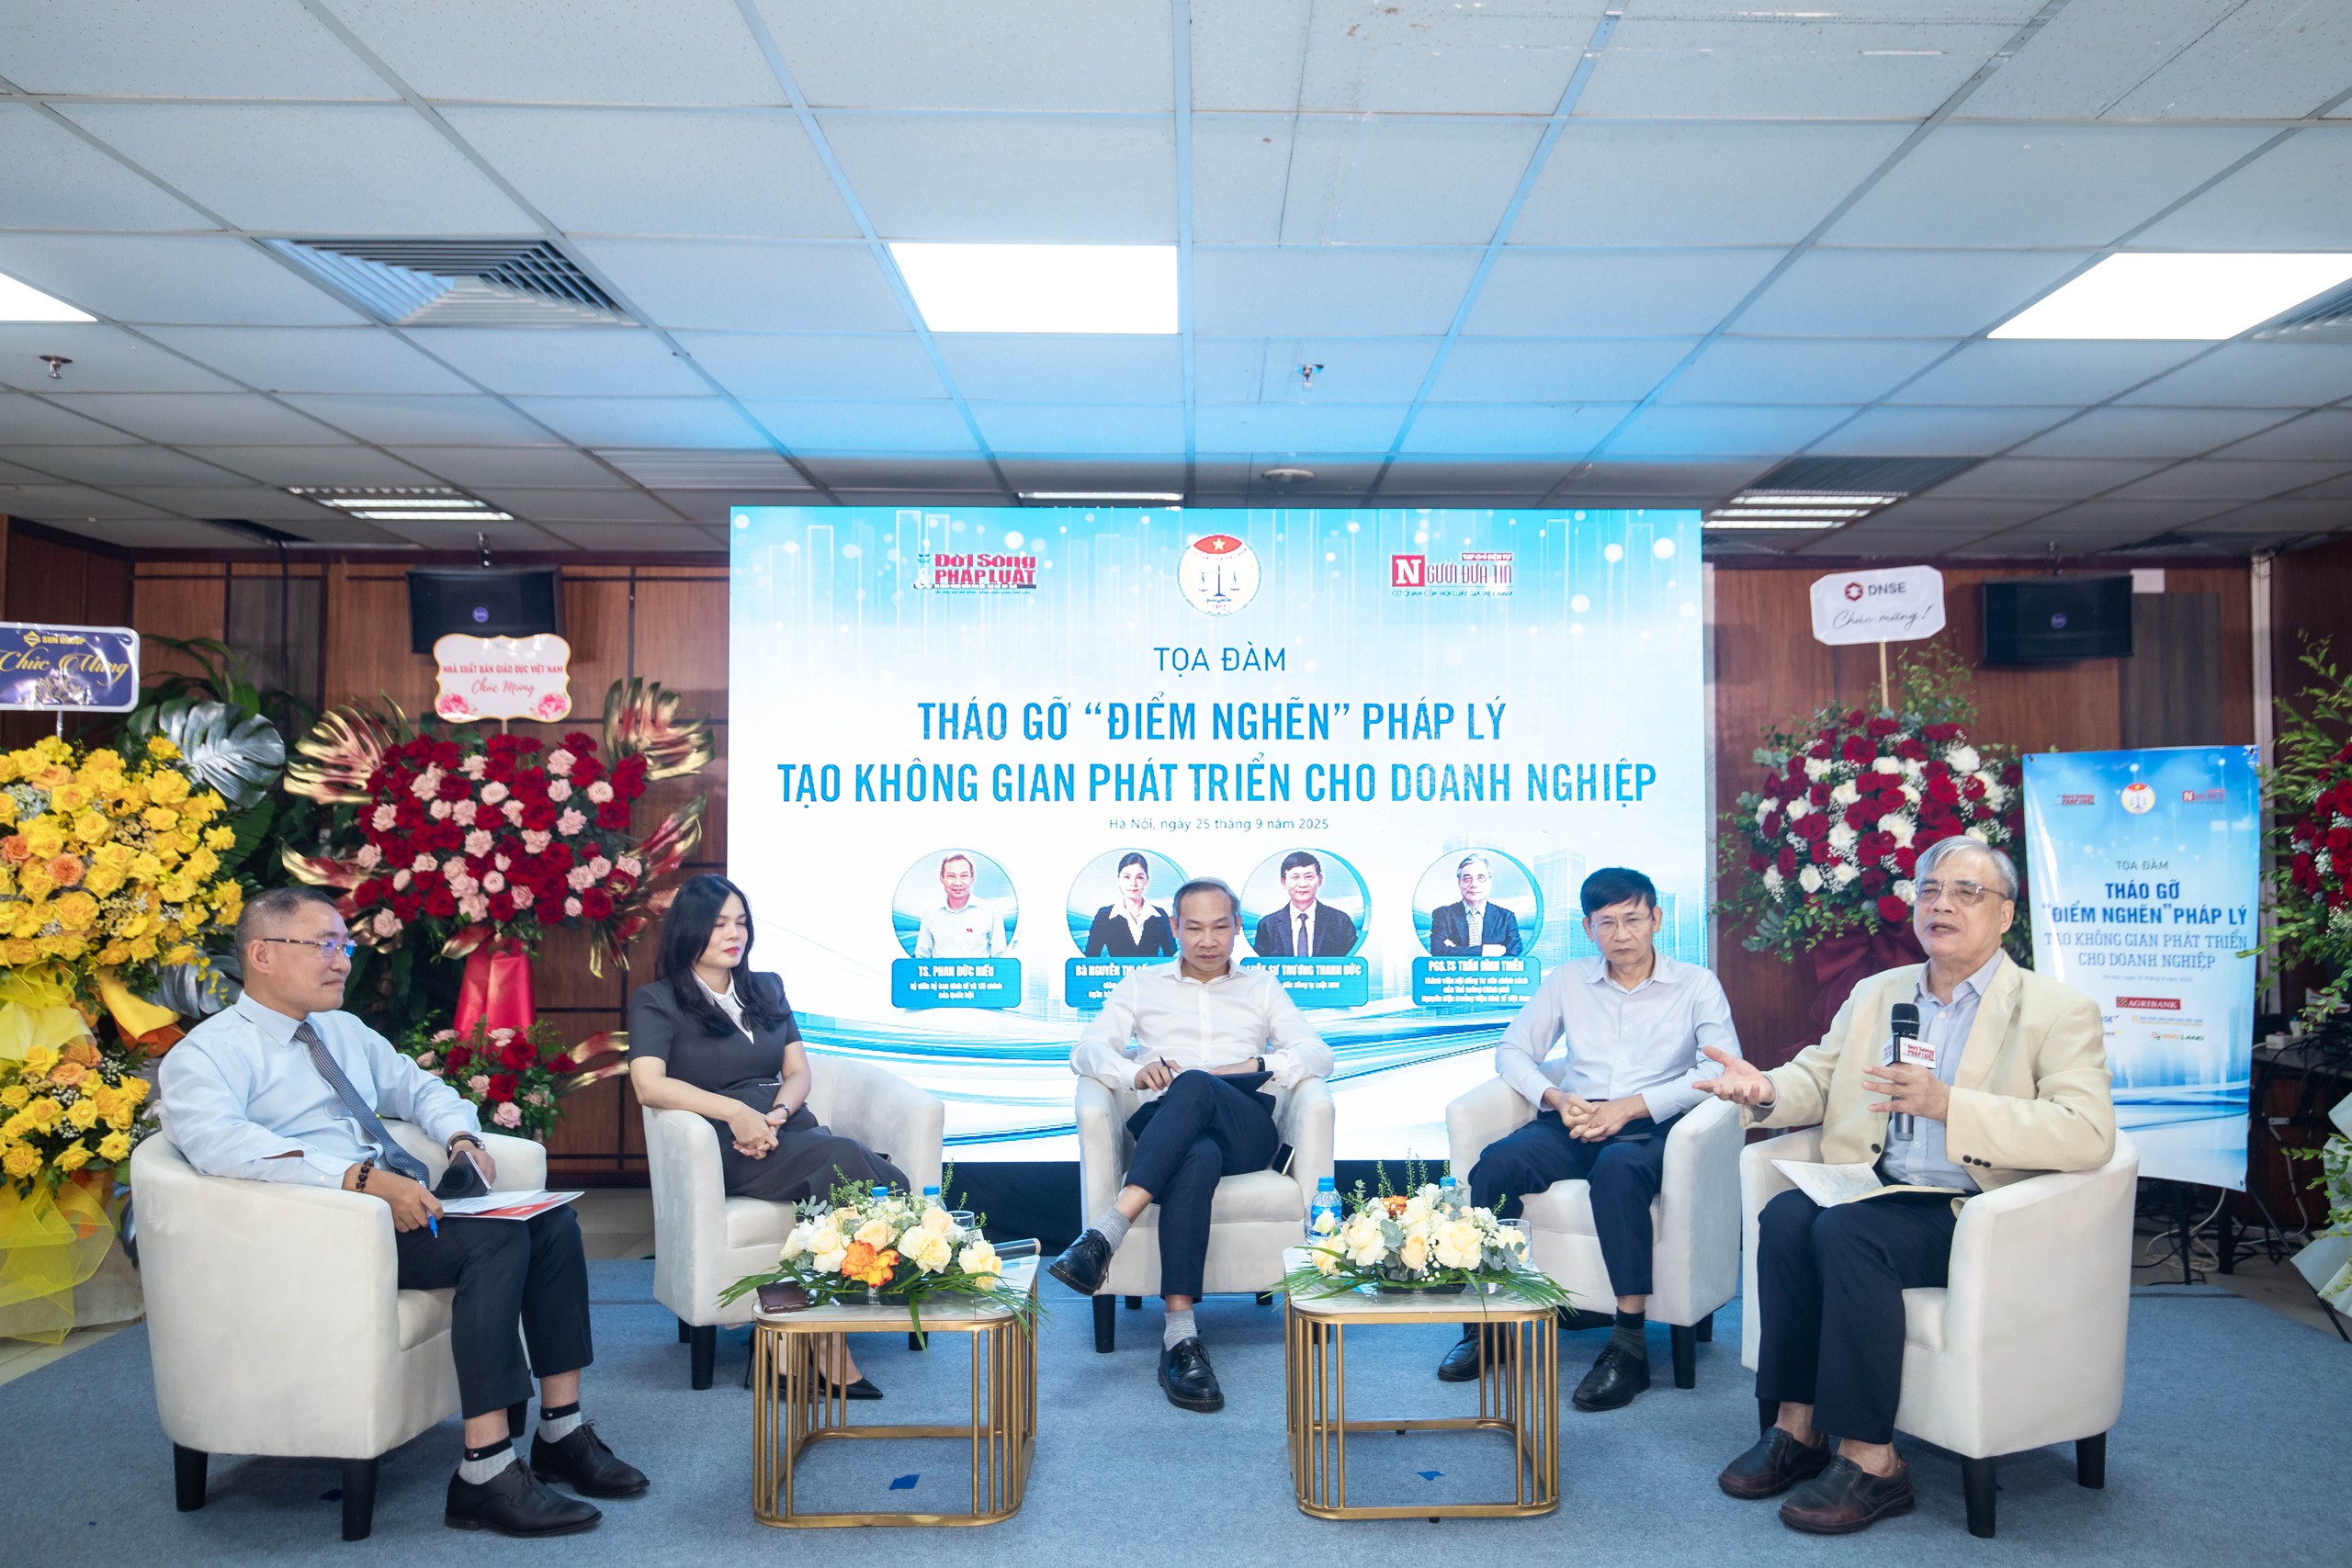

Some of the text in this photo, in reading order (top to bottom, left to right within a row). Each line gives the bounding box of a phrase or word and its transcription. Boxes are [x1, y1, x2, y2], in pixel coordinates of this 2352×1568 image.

[1868, 581, 1906, 596] DNSE
[1832, 609, 1874, 629] Chúc
[443, 662, 458, 674] NHÀ
[459, 662, 477, 674] XUẤT
[479, 663, 494, 674] BẢN
[496, 663, 513, 674] GIÁO
[530, 662, 545, 676] VIỆT
[547, 664, 563, 674] NAM
[1153, 641, 1284, 678] TỌA ĐÀM
[918, 695, 1008, 740] THÁO
[1023, 695, 1071, 740] GỠ
[1363, 695, 1454, 740] PHÁP
[1468, 695, 1506, 740] LÝ
[777, 752, 1657, 808] TẠO KHÔNG GIAN PHÁT TRIỂN CHO DOANH NGHIỆP
[1109, 818, 1126, 829] Hà
[1160, 818, 1192, 832] ngày
[1195, 818, 1210, 829] 25
[1215, 818, 1251, 832] tháng
[1255, 818, 1263, 829] 9
[1267, 818, 1295, 829] năm
[1298, 818, 1329, 829] 2025
[2143, 859, 2169, 871] ĐÀM
[2105, 879, 2180, 899] THÁO GỠ
[2174, 904, 2222, 925] PHÁP
[2229, 905, 2247, 925] LÝ
[2075, 930, 2121, 947] KHÔNG
[2125, 933, 2158, 947] GIAN
[2163, 931, 2201, 948] PHÁT
[2205, 929, 2247, 950] TRIỂN
[2078, 952, 2216, 972] CHO DOANH NGHIỆP
